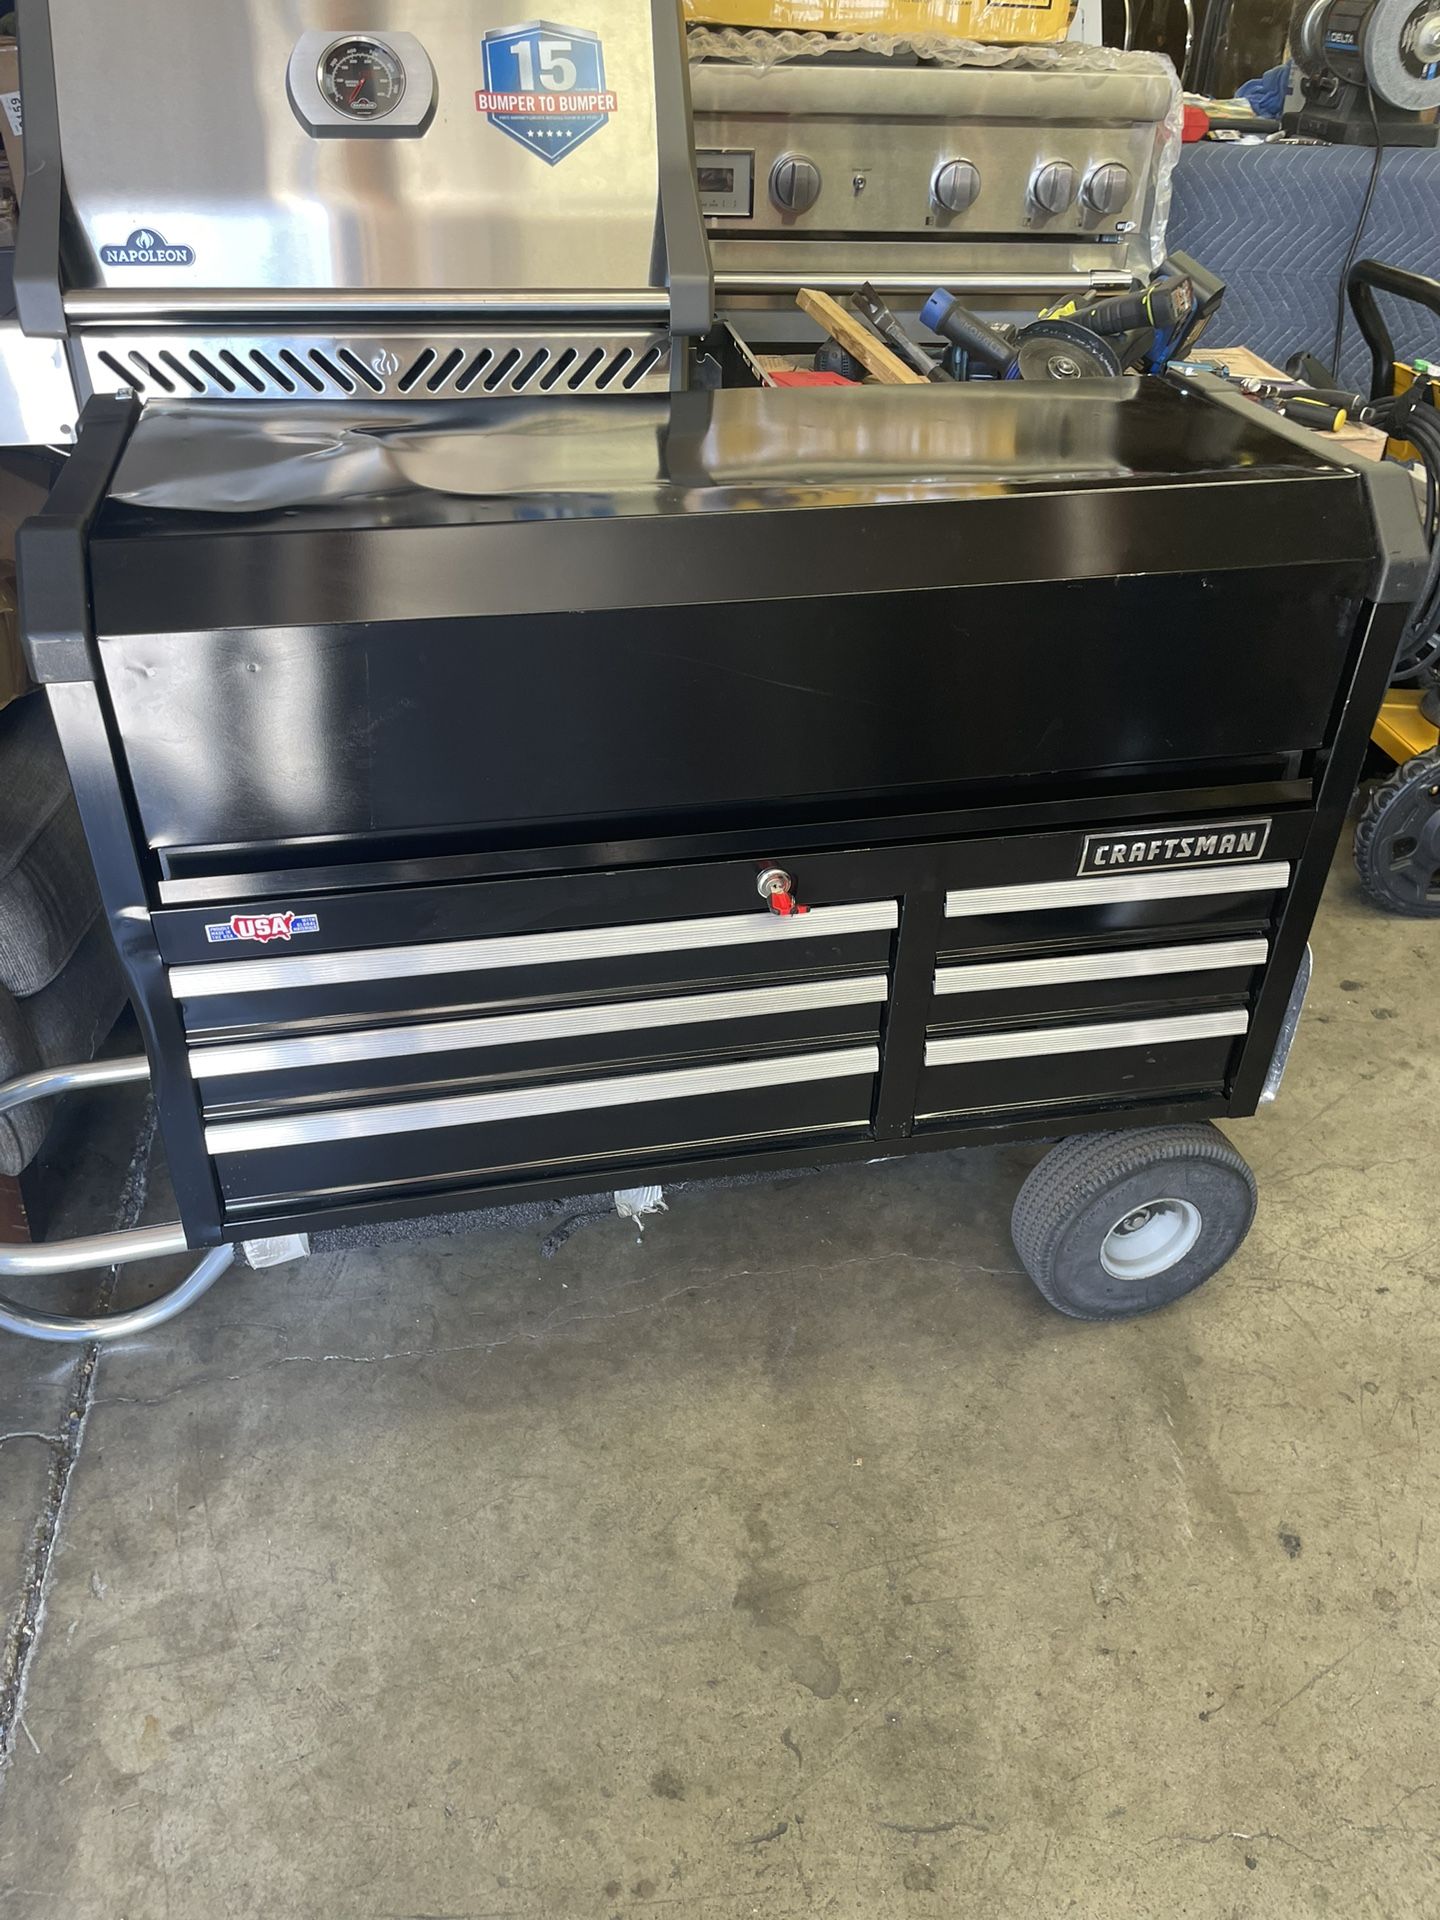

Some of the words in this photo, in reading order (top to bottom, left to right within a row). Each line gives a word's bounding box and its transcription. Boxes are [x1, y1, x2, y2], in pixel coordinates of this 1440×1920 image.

[1330, 31, 1354, 44] DELTA
[510, 40, 577, 91] 15
[478, 94, 535, 112] BUMPER
[538, 95, 555, 112] TO
[559, 94, 615, 112] BUMPER
[106, 249, 188, 262] NAPOLEON
[1093, 831, 1257, 866] CRAFTSMAN
[237, 916, 289, 938] USA
